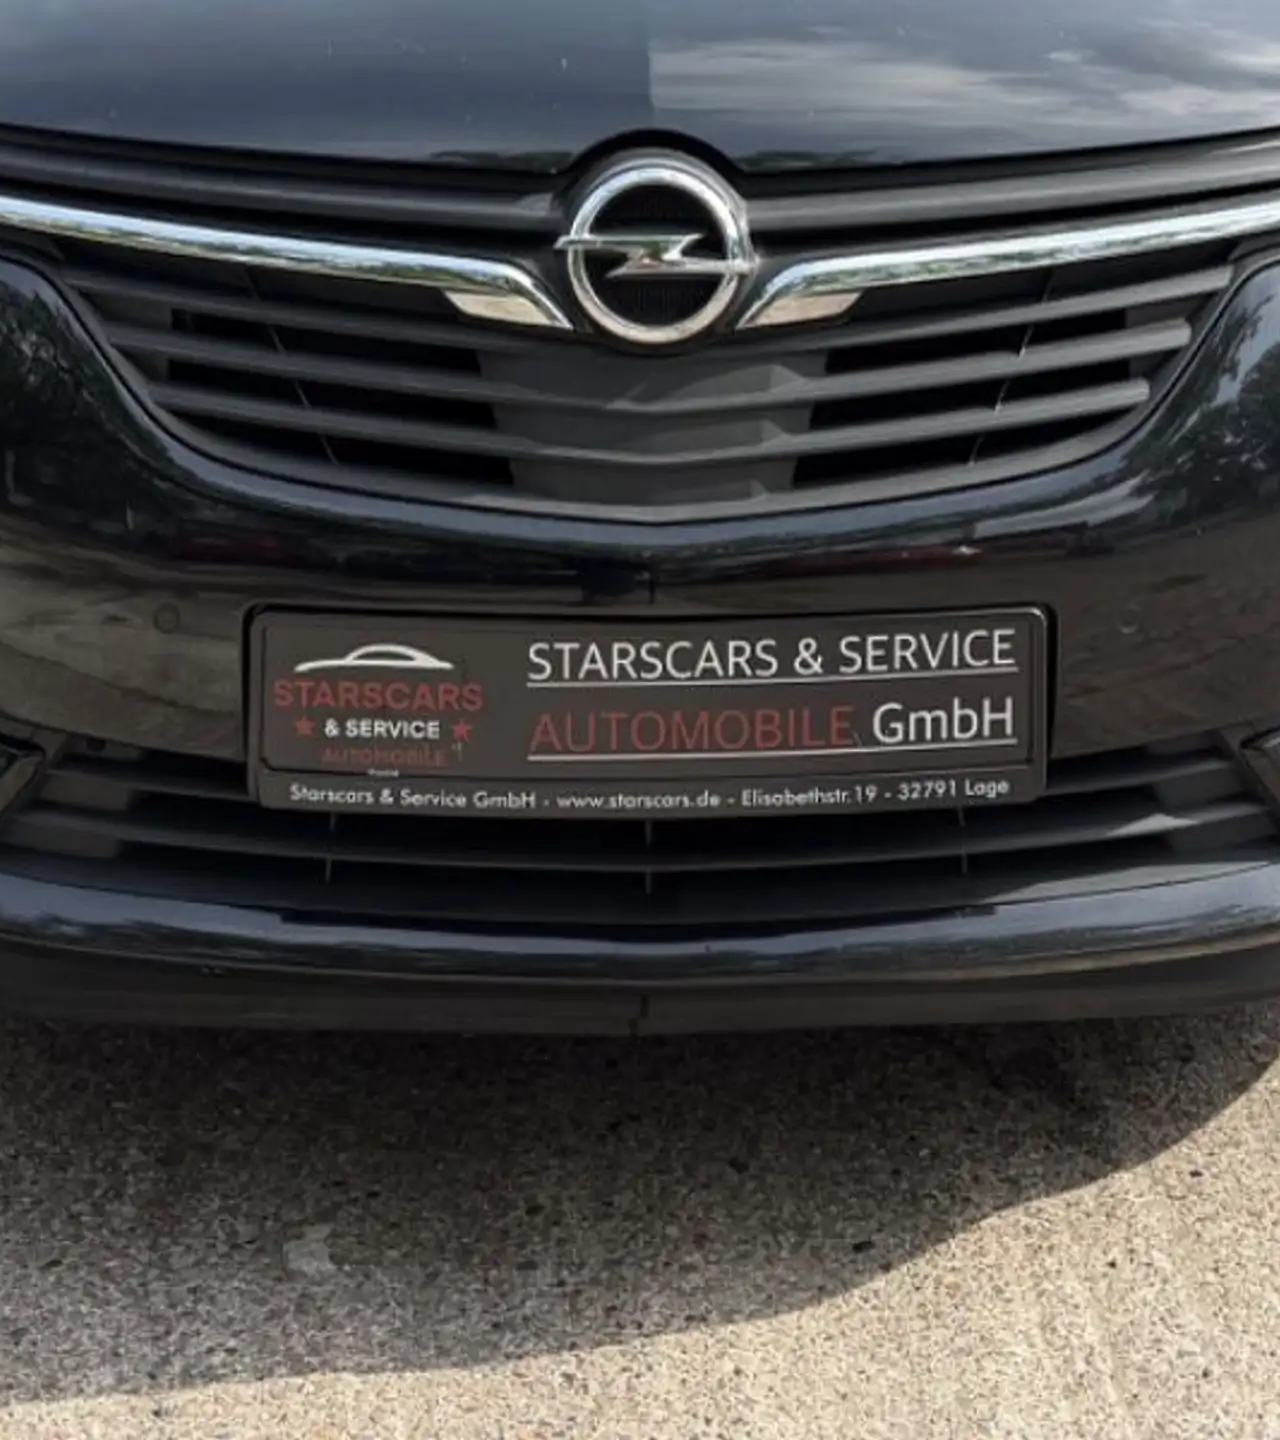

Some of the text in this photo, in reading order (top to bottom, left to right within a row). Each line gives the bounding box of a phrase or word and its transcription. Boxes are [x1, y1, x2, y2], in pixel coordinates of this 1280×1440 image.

[527, 628, 1017, 681] STARSCARS & SERVICE
[274, 679, 484, 711] STARSCARS
[324, 718, 441, 739] & SERVICE
[529, 696, 1014, 752] AUTOMOBILE GmbH
[289, 783, 374, 804] Starscars
[379, 786, 394, 805] &
[400, 788, 467, 808] Service
[473, 791, 537, 808] GmbH
[556, 790, 721, 809] www.starscars.de
[897, 779, 957, 800] 32791
[965, 779, 1010, 798] Lage
